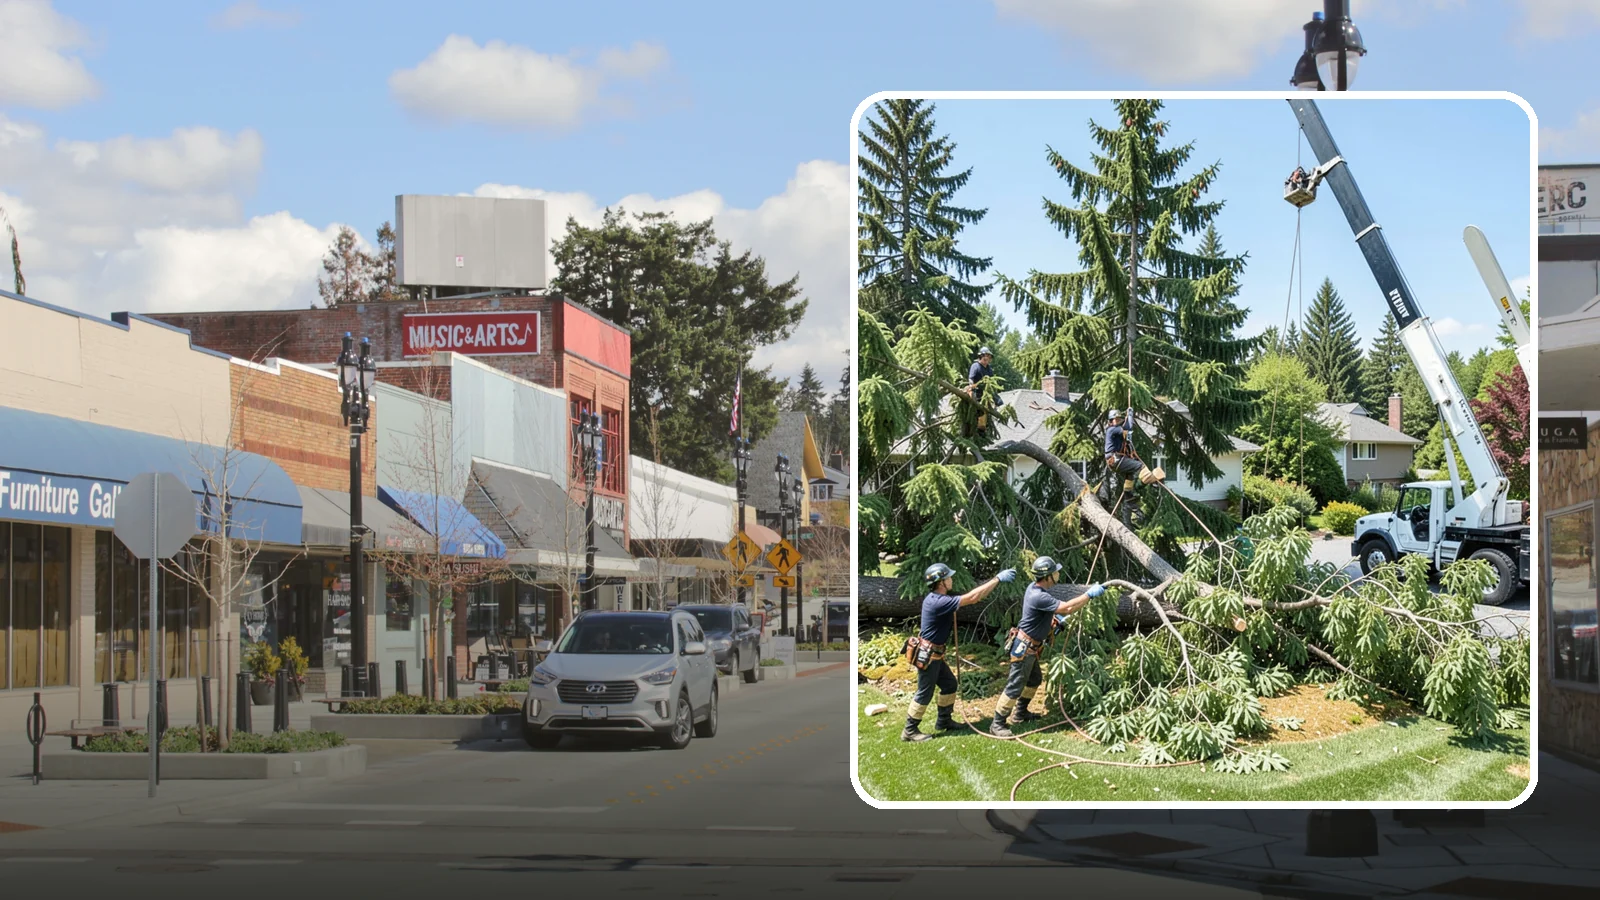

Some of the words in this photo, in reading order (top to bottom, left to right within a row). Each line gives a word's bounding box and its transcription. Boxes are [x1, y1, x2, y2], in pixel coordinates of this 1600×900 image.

[0, 471, 79, 515] Furniture
[89, 482, 122, 519] Gal
[453, 563, 479, 574] SUSHI
